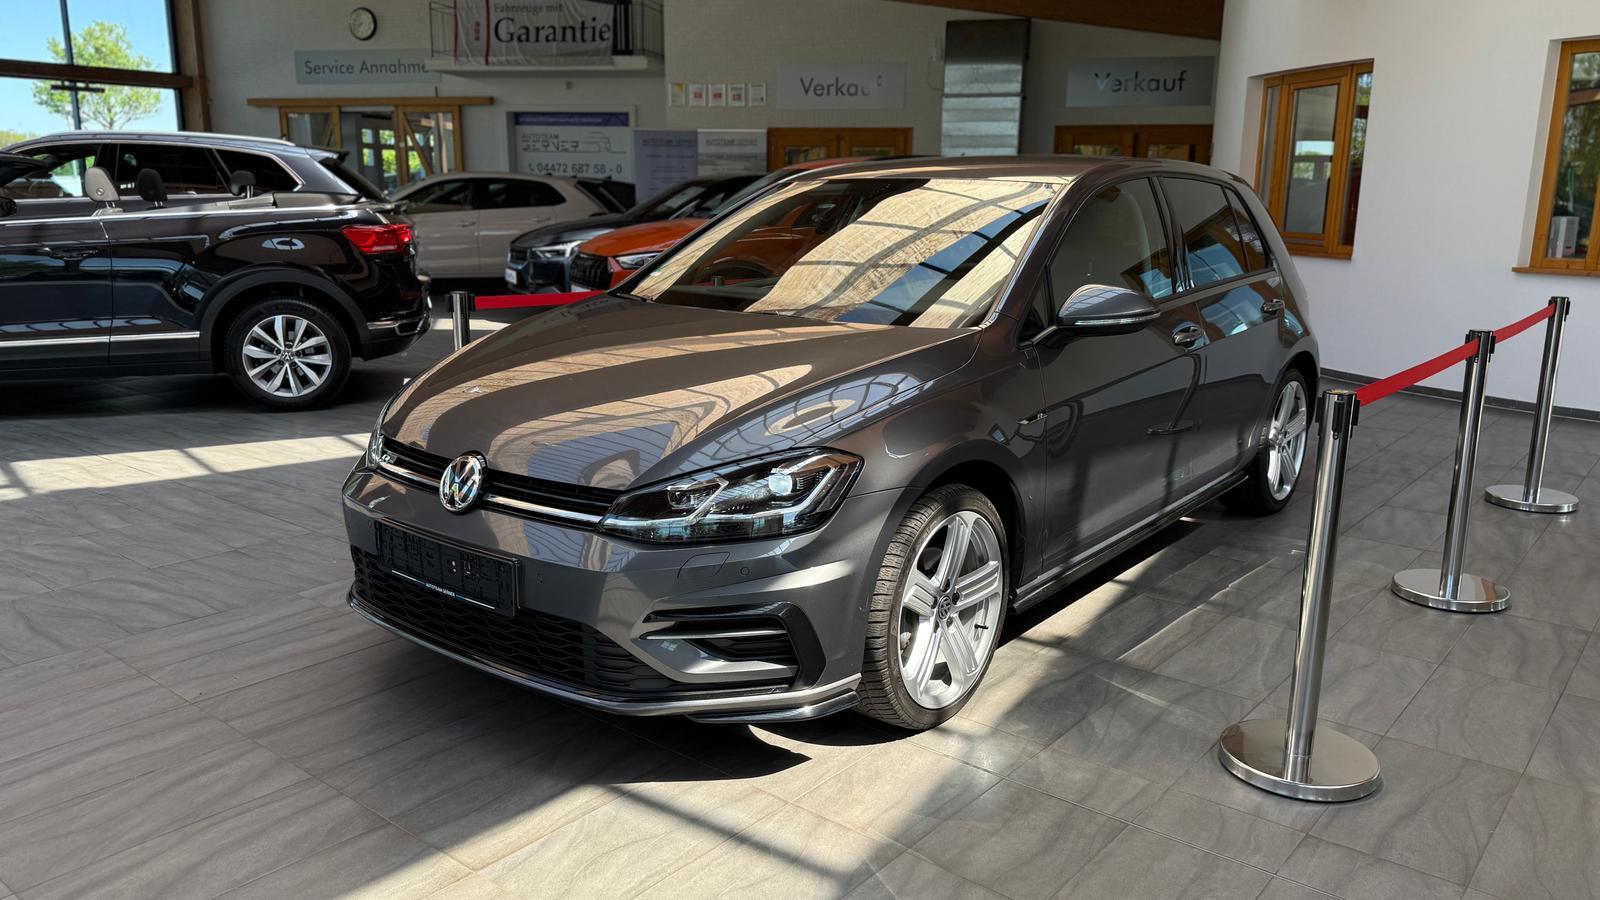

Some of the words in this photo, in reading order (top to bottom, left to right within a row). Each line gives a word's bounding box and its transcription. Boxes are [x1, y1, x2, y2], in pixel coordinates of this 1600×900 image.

[494, 3, 543, 14] Fahrzeuge
[545, 2, 564, 12] mit
[494, 16, 611, 43] Garantie
[304, 59, 354, 75] Service
[1093, 70, 1188, 93] Verkauf
[536, 162, 568, 174] 04472
[571, 163, 590, 174] 687
[616, 163, 623, 174] 0
